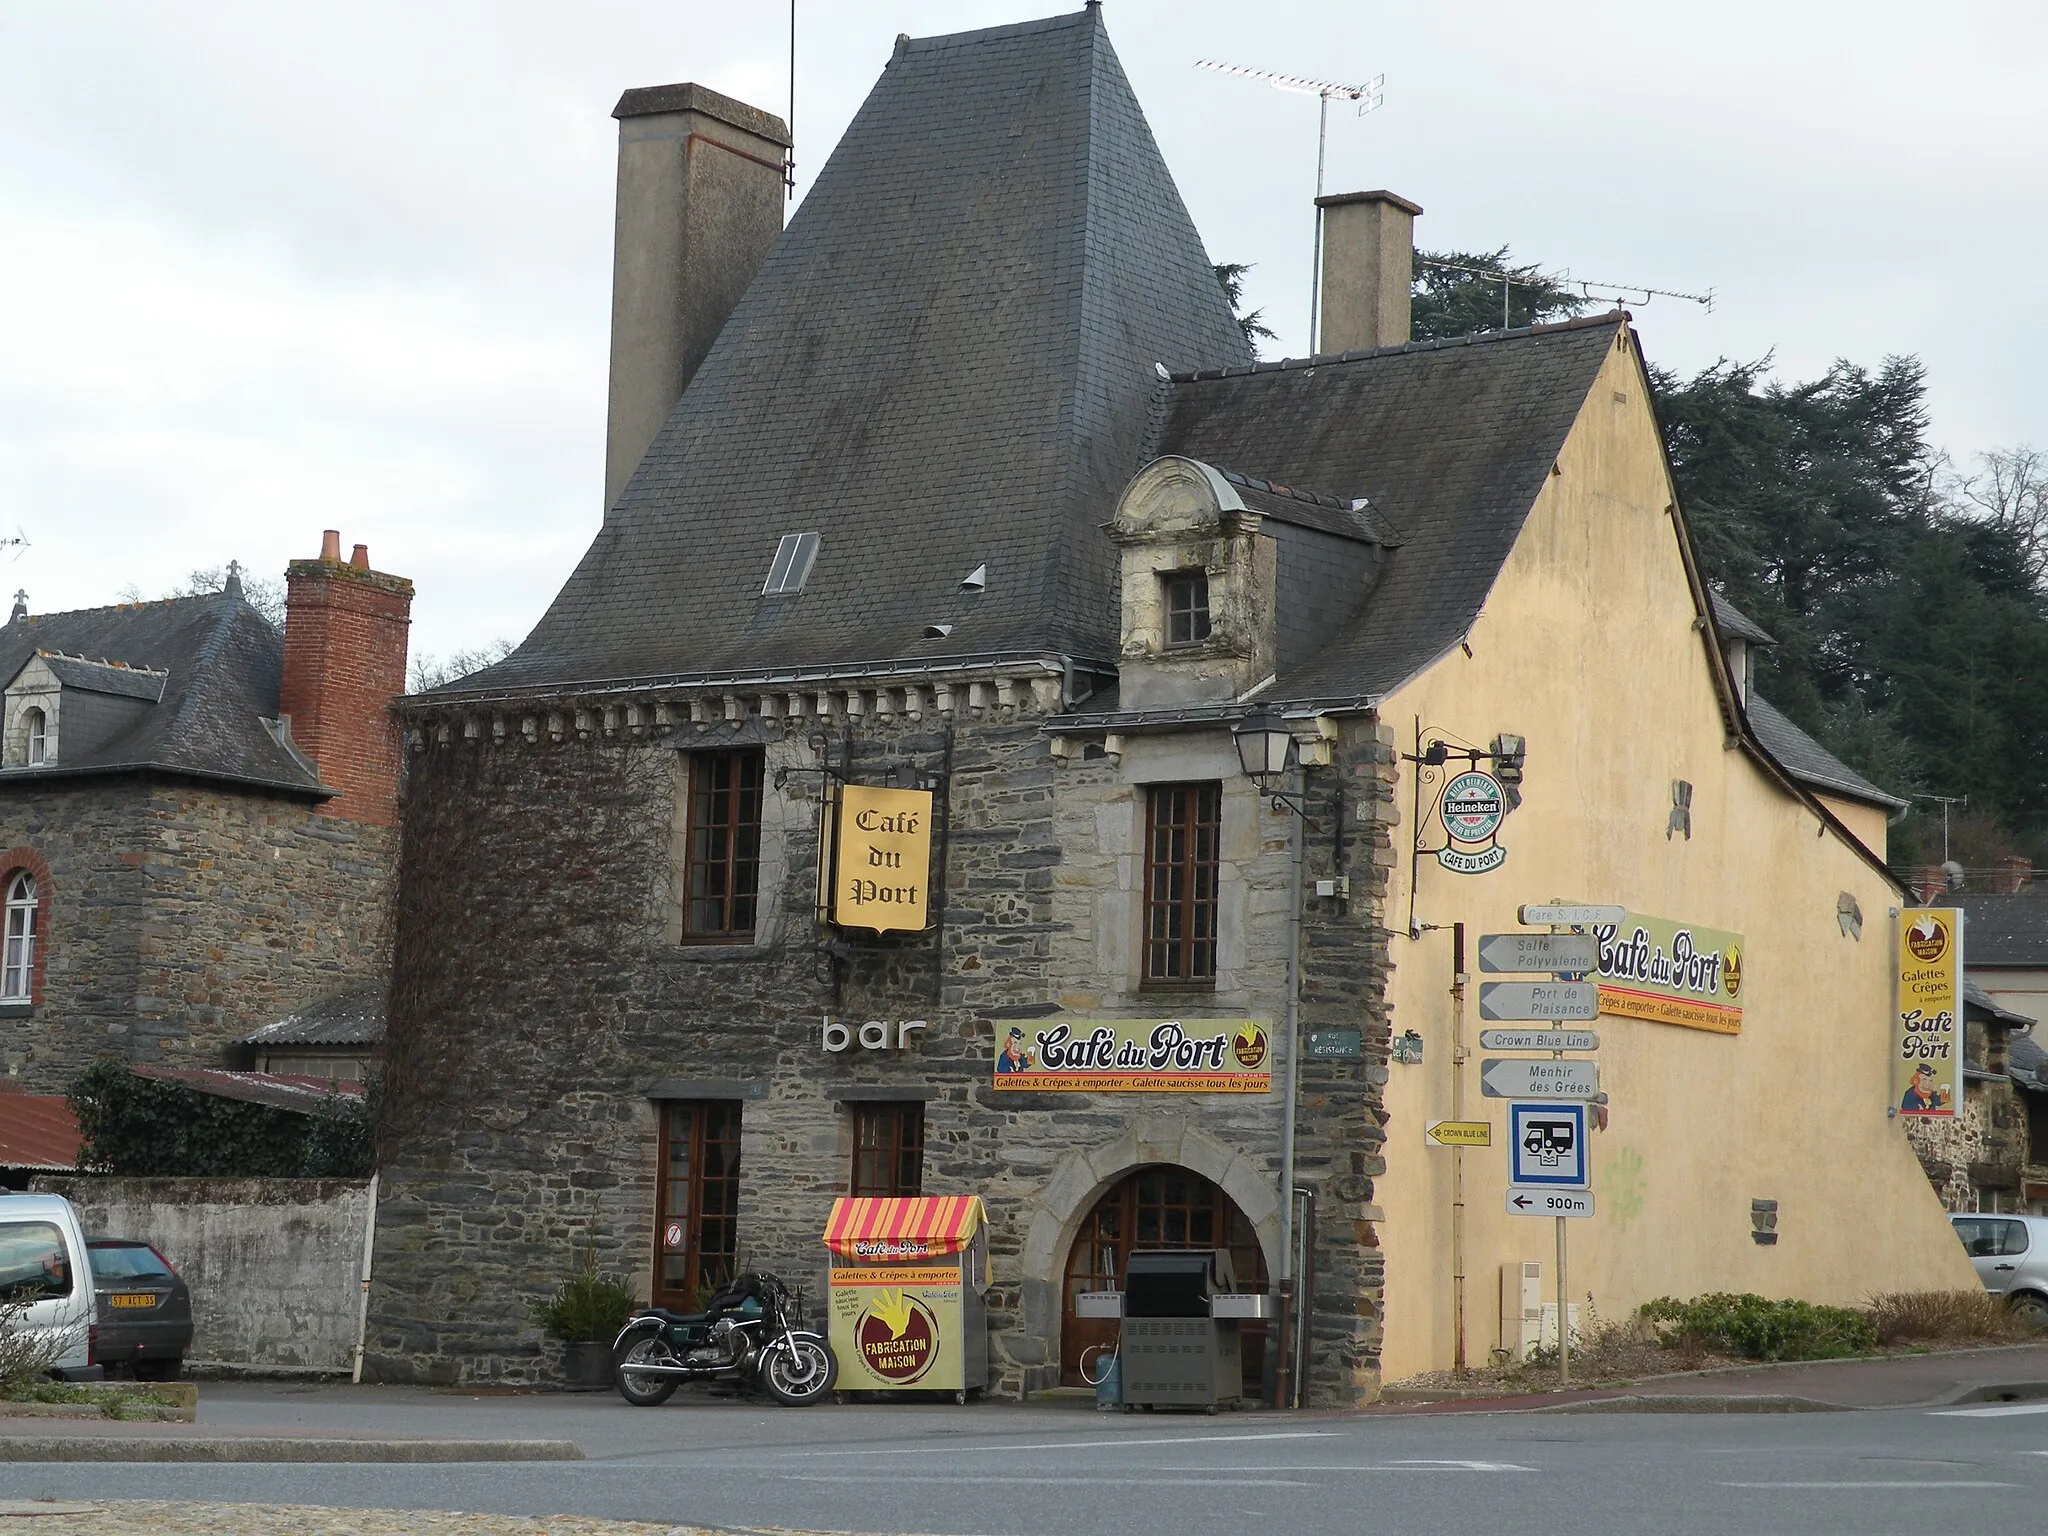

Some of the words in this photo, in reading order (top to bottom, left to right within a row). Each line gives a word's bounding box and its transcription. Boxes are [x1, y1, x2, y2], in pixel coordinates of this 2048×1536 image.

[1447, 801, 1497, 813] Heineken
[855, 809, 919, 834] Café
[868, 845, 901, 868] du
[1444, 852, 1463, 868] CAFE
[1465, 858, 1476, 869] DU
[1478, 850, 1499, 867] PORT
[848, 878, 918, 906] Port
[1518, 940, 1549, 952] Salle
[1517, 955, 1589, 968] Polyvalente
[1592, 925, 1650, 980] Café
[1651, 947, 1670, 983] du
[1672, 929, 1720, 993] Port
[1901, 969, 1945, 982] Galettes
[1531, 988, 1557, 999] Port
[1564, 988, 1578, 999] de
[1912, 981, 1948, 994] Crêpes
[1924, 995, 1952, 1004] emporter
[1531, 1003, 1590, 1015] Plaisance
[1626, 1000, 1656, 1014] emporter
[1660, 1003, 1682, 1018] Galette
[1727, 1015, 1742, 1029] jours
[1901, 1009, 1952, 1033] Café
[822, 1015, 927, 1052] bar
[1495, 1033, 1531, 1046] Crown
[1536, 1034, 1561, 1046] Blue
[1566, 1035, 1590, 1047] Line
[1927, 1032, 1940, 1042] du
[1037, 1024, 1115, 1070] Café
[1117, 1040, 1146, 1067] du
[1148, 1022, 1226, 1070] Port
[1902, 1035, 1951, 1059] Port
[1529, 1065, 1573, 1078] Menhir
[996, 1077, 1030, 1087] Galettes
[1032, 1077, 1040, 1087] &
[1042, 1077, 1073, 1089] Crêpes
[1074, 1078, 1080, 1087] à
[1082, 1079, 1124, 1089] emporter
[1132, 1078, 1165, 1088] Galette
[1167, 1078, 1204, 1088] saucisse
[1206, 1079, 1226, 1088] tous
[1228, 1078, 1242, 1089] les
[1243, 1079, 1268, 1090] jours
[1529, 1081, 1550, 1092] des
[1555, 1081, 1591, 1094] Grées
[1443, 1129, 1462, 1137] CROWN
[1463, 1130, 1476, 1138] BLUE
[1546, 1197, 1585, 1210] 900m
[855, 1241, 886, 1255] Café
[886, 1245, 898, 1254] du
[899, 1240, 928, 1253] Port
[833, 1271, 868, 1280] Galettes
[869, 1271, 877, 1280] &
[910, 1271, 916, 1279] à
[917, 1271, 958, 1281] emporter
[835, 1289, 857, 1297] Galette
